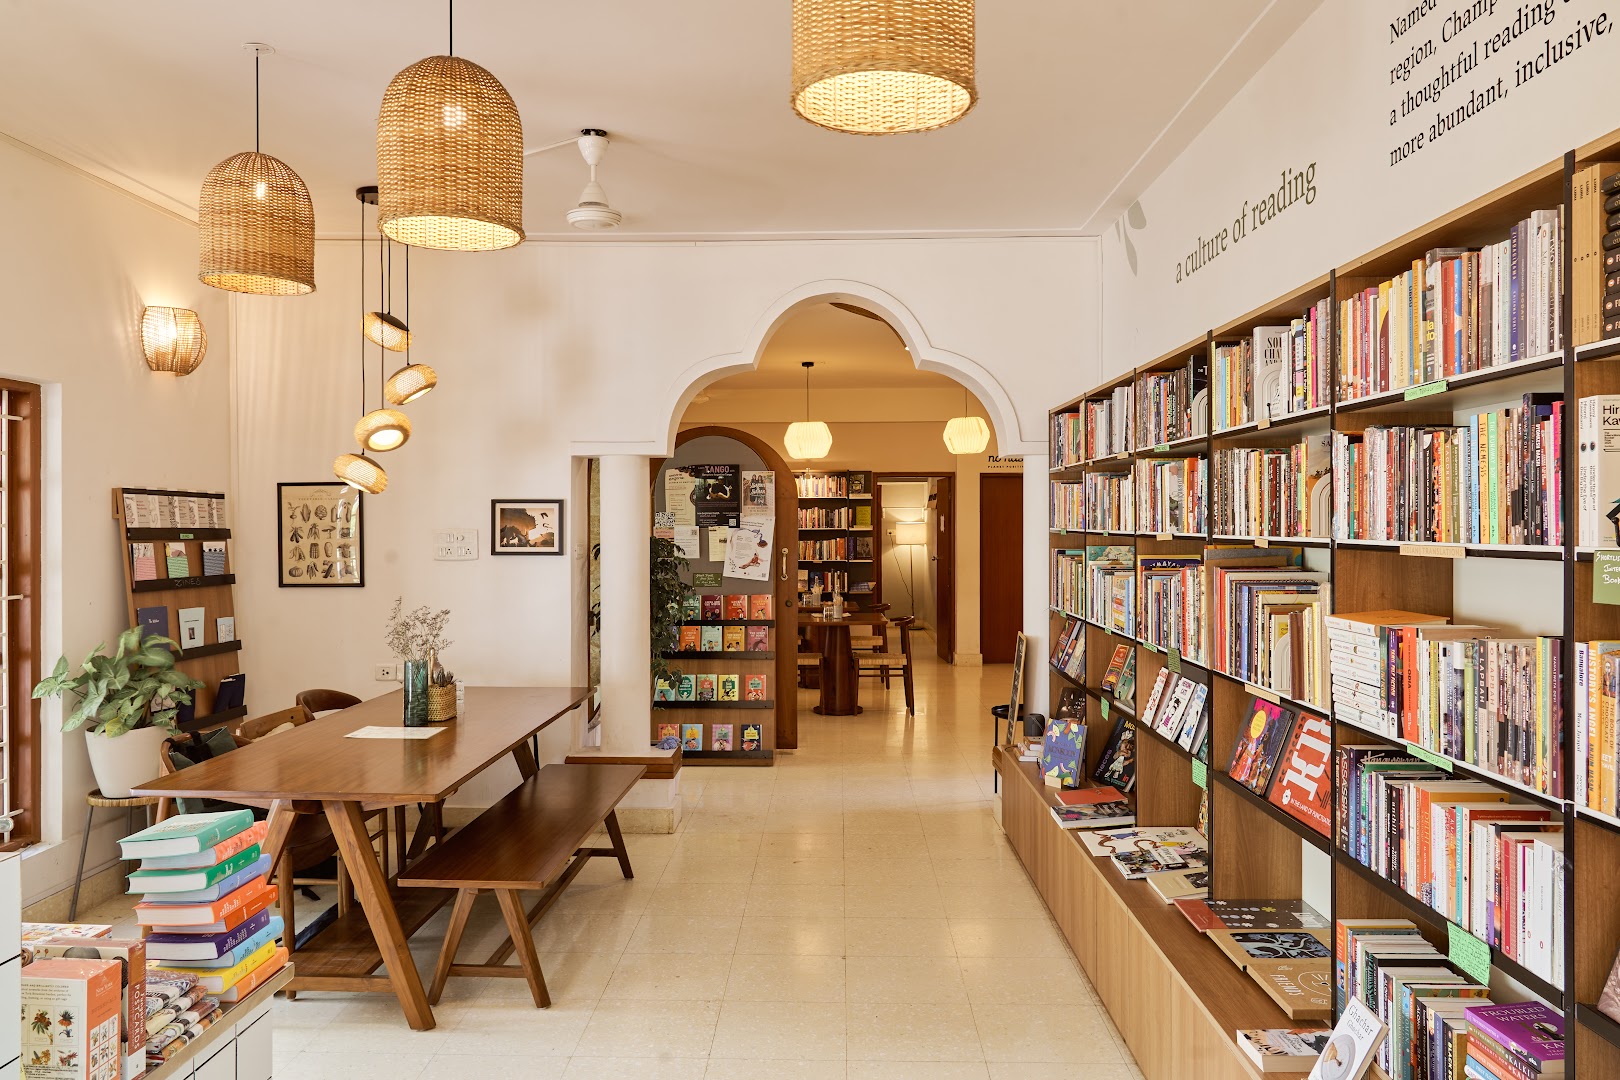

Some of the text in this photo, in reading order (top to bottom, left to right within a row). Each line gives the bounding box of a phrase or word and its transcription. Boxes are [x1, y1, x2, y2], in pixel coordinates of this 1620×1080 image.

[1390, 0, 1437, 45] Named
[1390, 0, 1498, 86] region, Champ
[1390, 0, 1556, 126] a thoughtful reading
[1390, 12, 1614, 167] more abundant, inclusive,
[1176, 162, 1317, 284] a culture of reading
[1603, 404, 1620, 414] Hir
[175, 578, 201, 587] ZINES
[1589, 649, 1597, 703] HISTORY'S
[1349, 1004, 1373, 1036] Ghachar
[1479, 1006, 1544, 1017] TROUBLED
[1497, 1013, 1546, 1022] WATERS
[1509, 1056, 1530, 1076] KALKI
